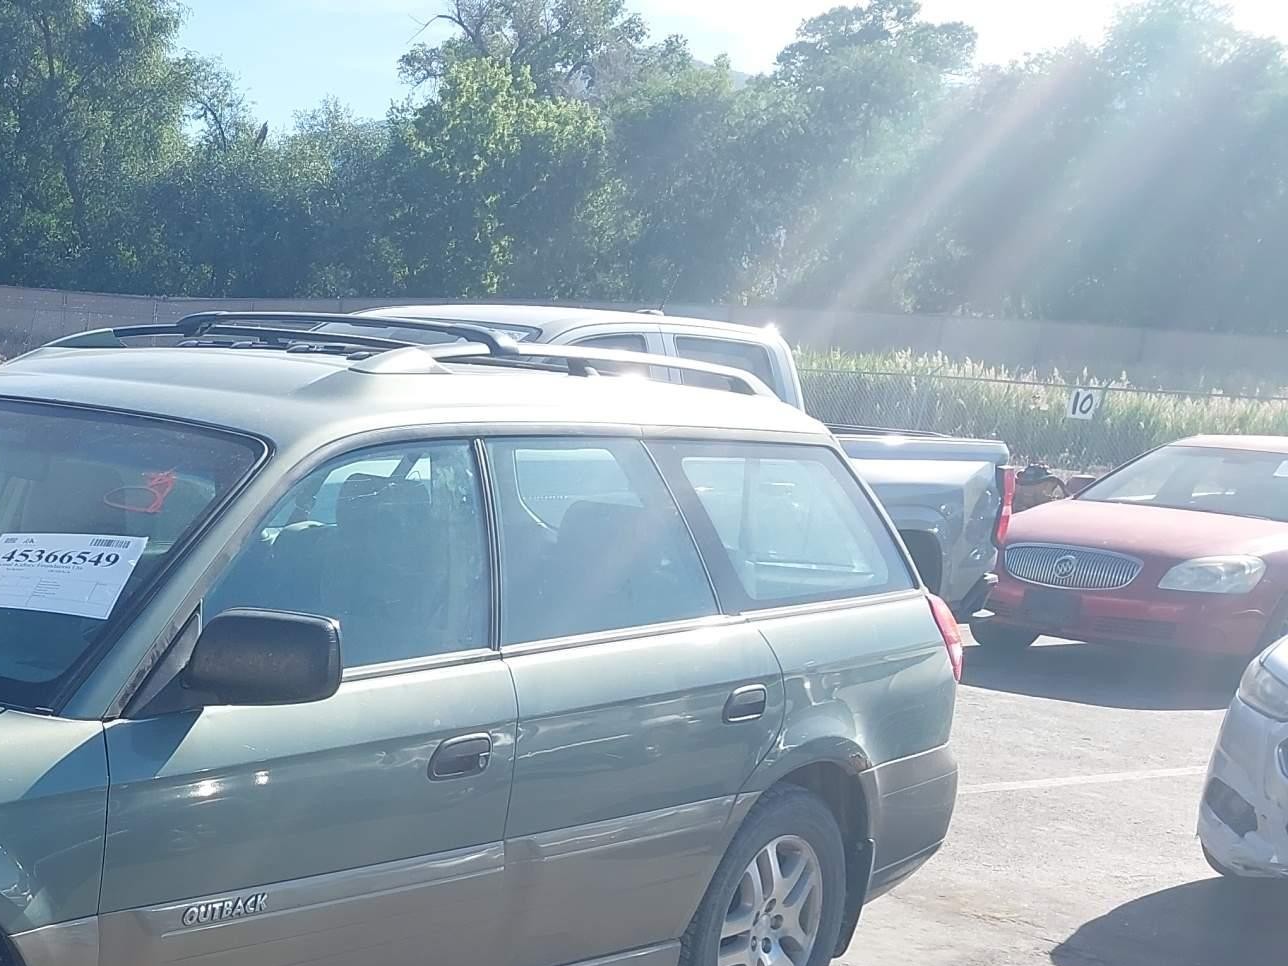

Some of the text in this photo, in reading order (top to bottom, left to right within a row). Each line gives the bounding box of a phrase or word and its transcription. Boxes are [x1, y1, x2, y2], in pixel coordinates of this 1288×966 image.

[1071, 391, 1094, 415] 10
[1, 549, 120, 568] 45366549
[182, 893, 268, 926] OUTBACK
